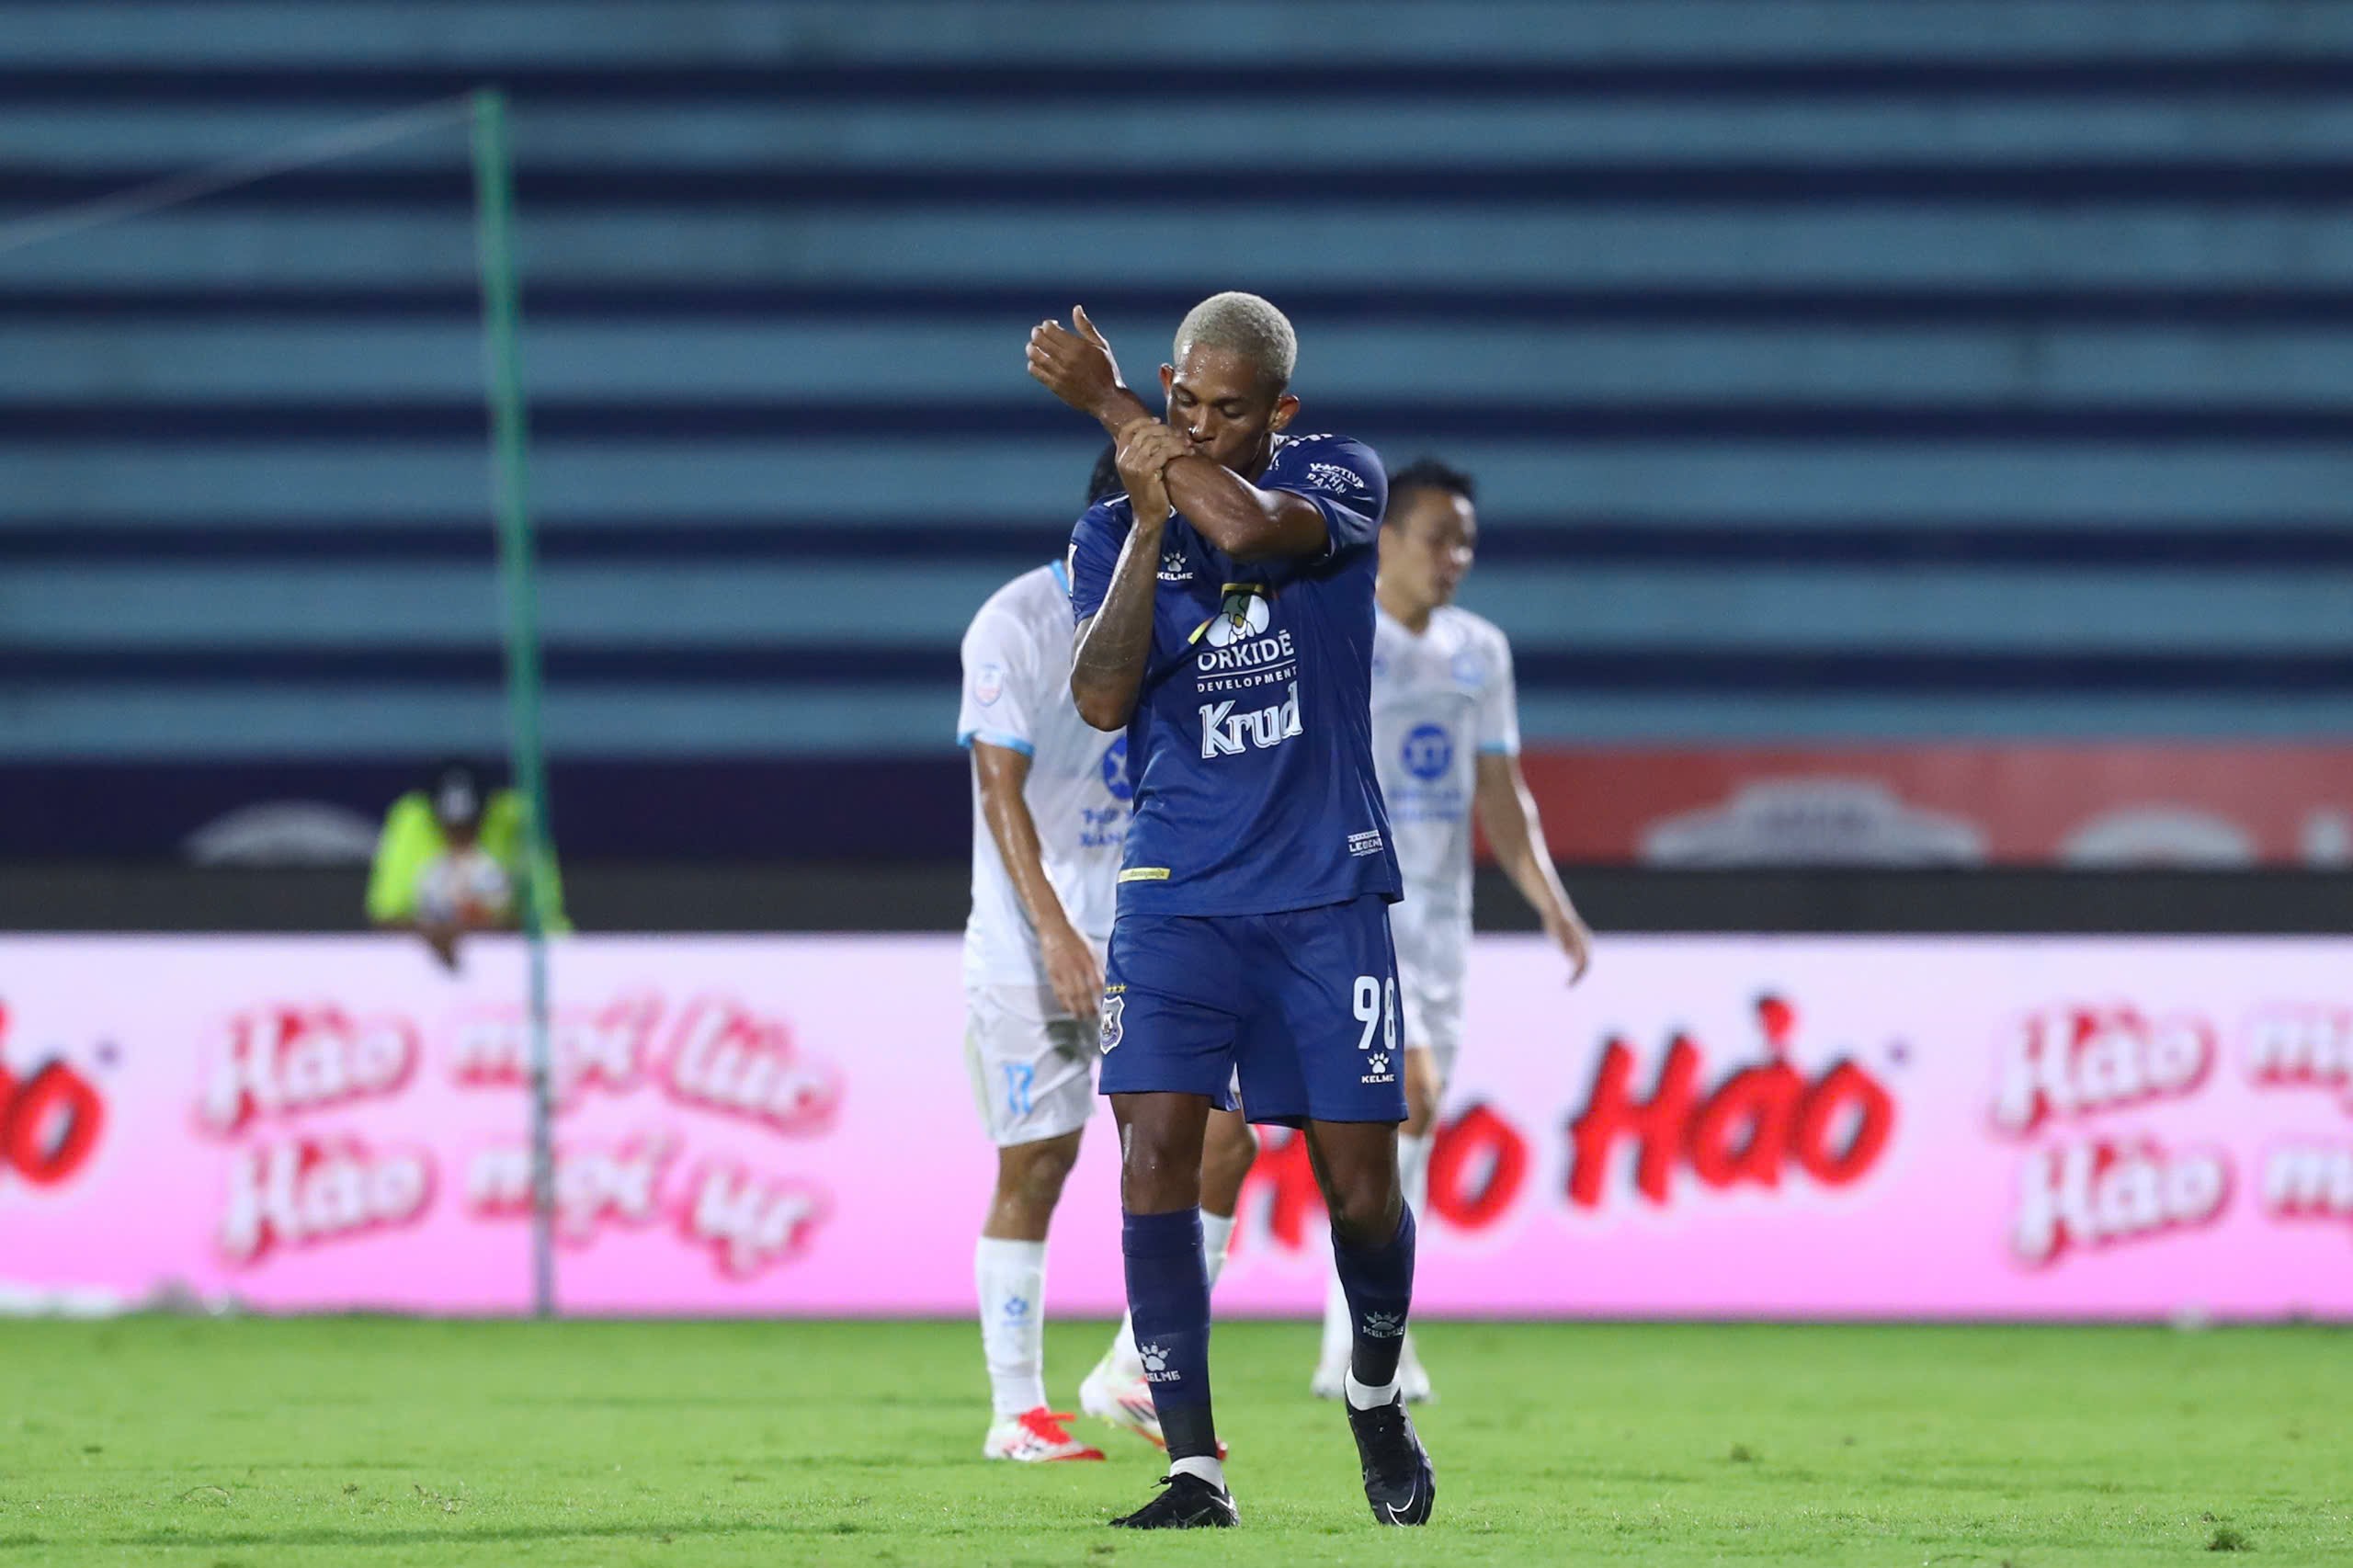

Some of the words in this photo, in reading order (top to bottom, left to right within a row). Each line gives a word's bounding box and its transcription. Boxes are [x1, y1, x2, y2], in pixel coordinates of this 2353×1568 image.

[1156, 572, 1194, 581] KELME
[1197, 666, 1298, 693] DEVELOPMENT
[1199, 680, 1303, 759] Krud
[1348, 837, 1383, 853] LEGEN
[1353, 975, 1396, 1050] 98
[1361, 1074, 1394, 1084] KELME
[1563, 994, 1896, 1210] Hảo
